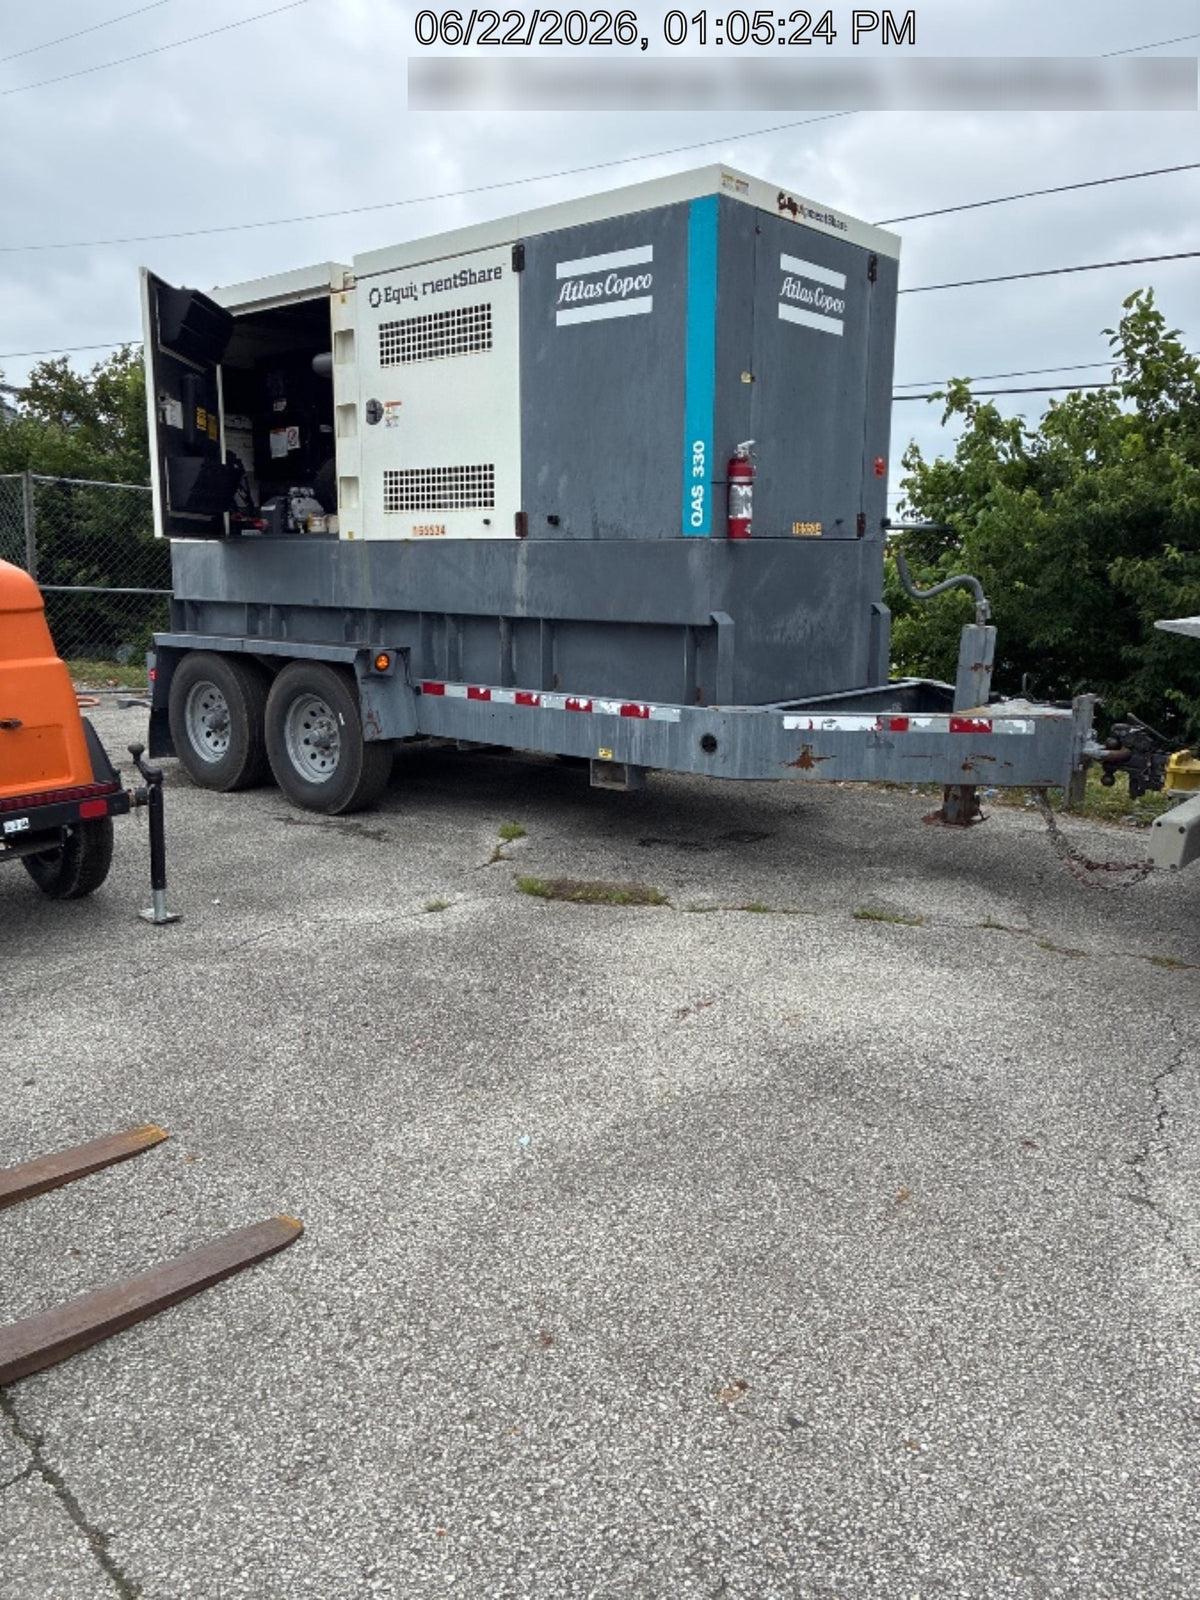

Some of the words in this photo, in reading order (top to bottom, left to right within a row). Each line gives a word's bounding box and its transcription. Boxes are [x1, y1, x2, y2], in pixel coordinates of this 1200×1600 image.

[556, 280, 604, 304] Atlas
[604, 273, 653, 298] Copco
[780, 276, 814, 304] Atlas
[814, 287, 846, 314] Copco
[693, 440, 705, 478] 330
[691, 484, 705, 527] QAS
